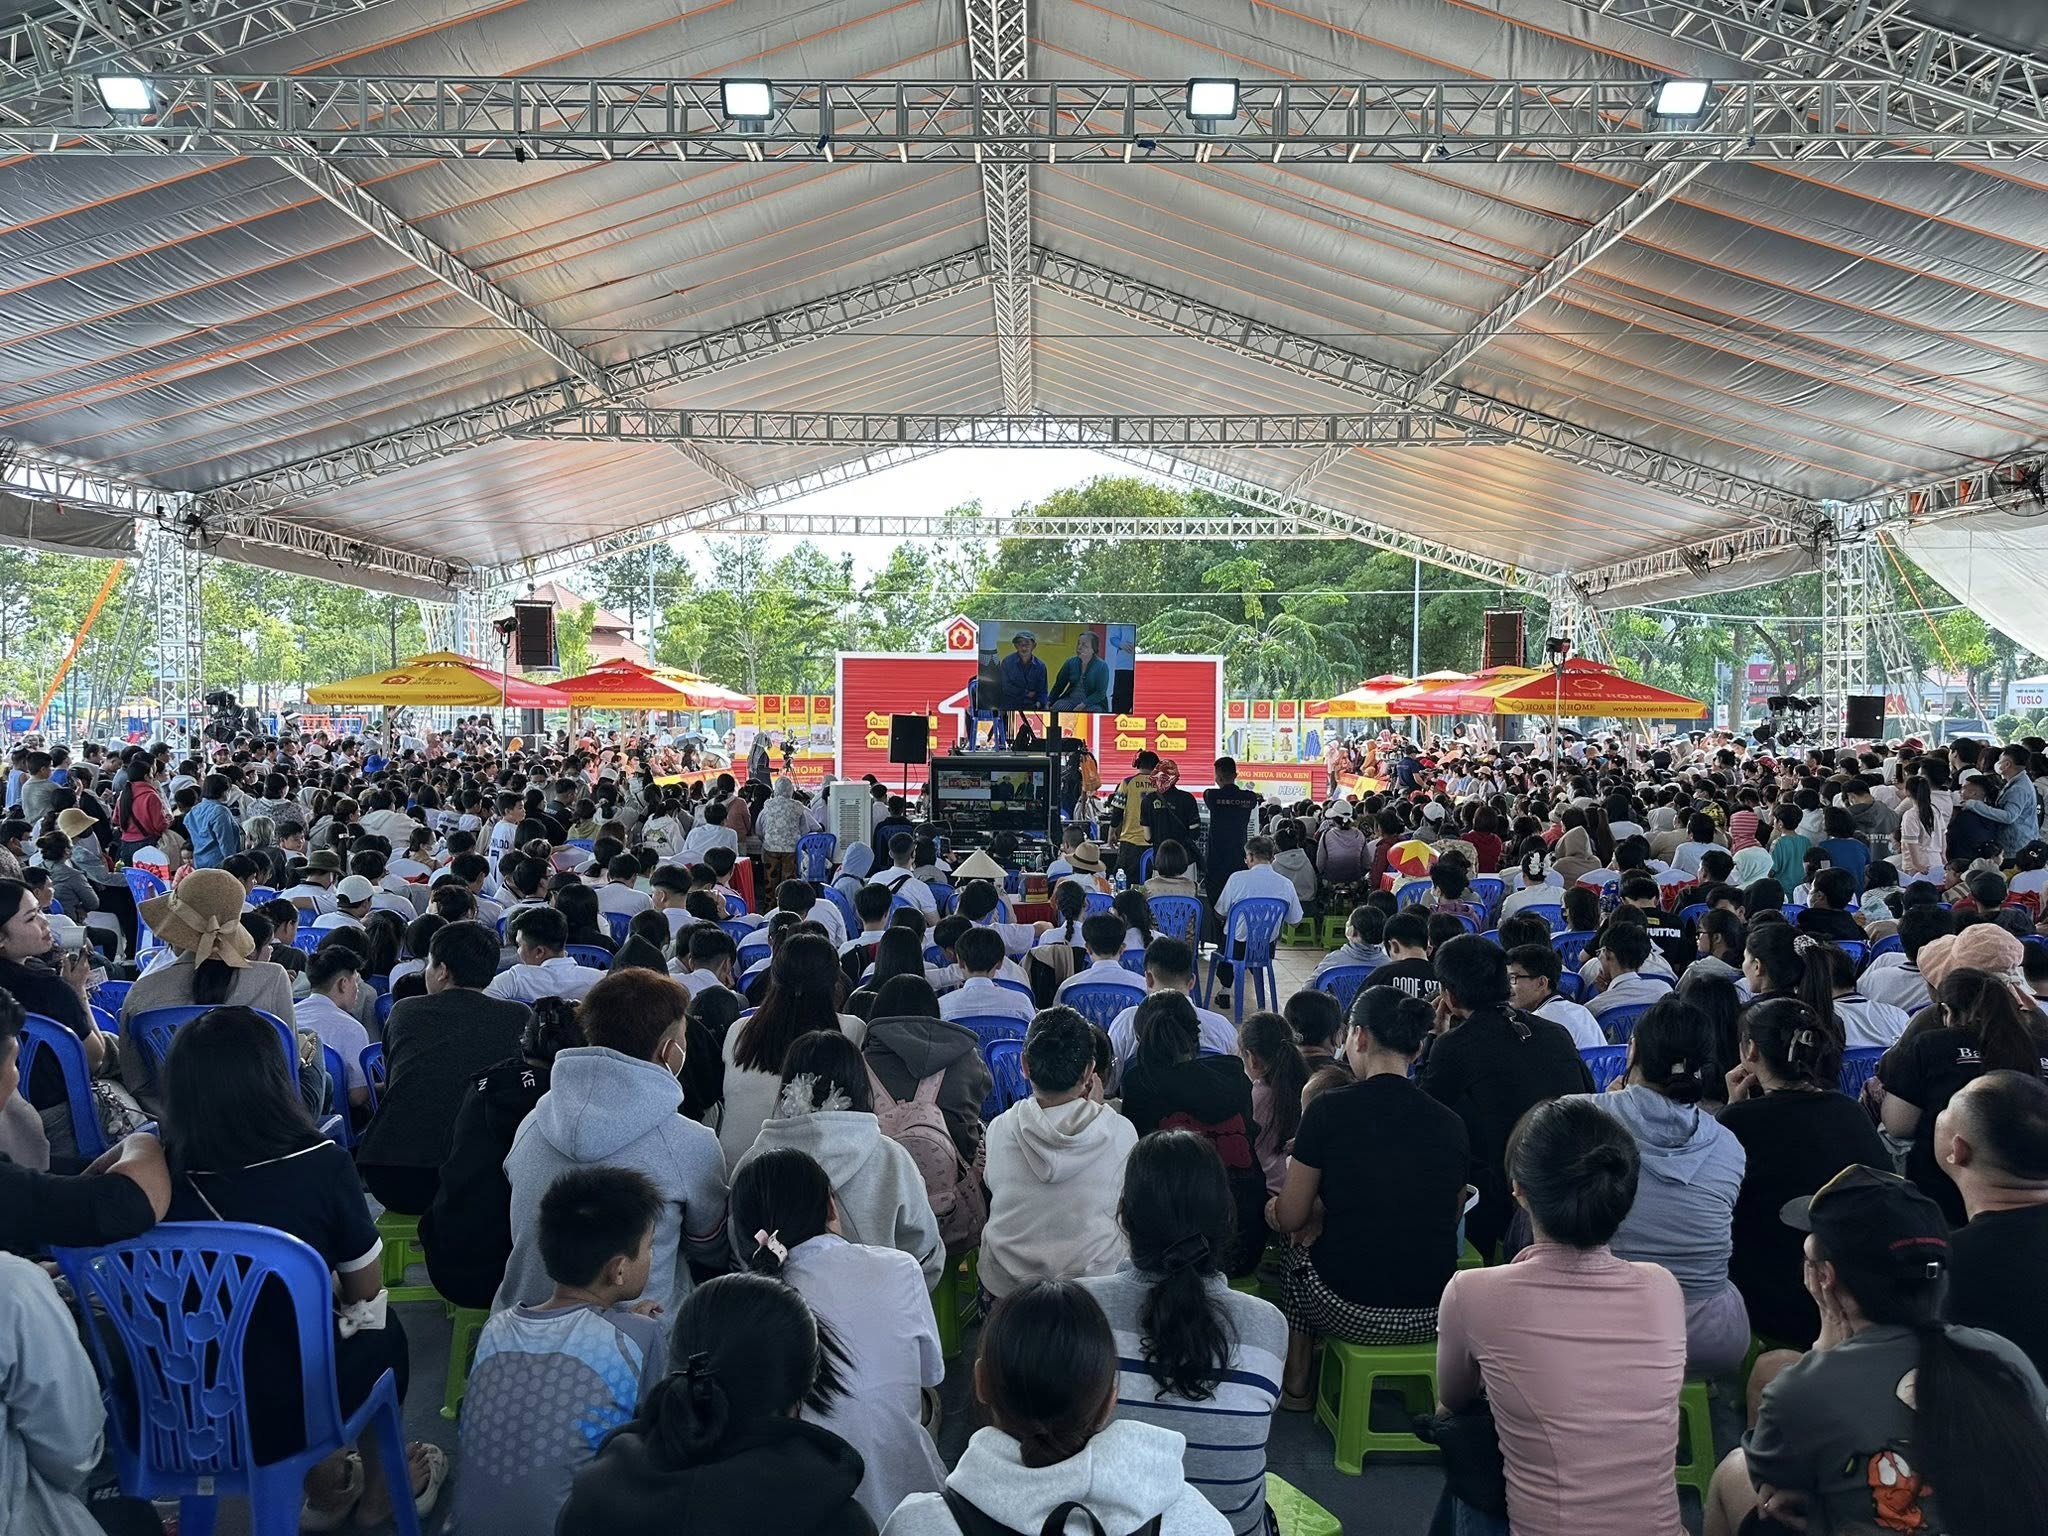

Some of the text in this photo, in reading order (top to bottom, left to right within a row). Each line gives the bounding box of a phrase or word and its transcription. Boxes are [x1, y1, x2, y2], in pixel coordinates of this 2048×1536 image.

[2016, 695, 2043, 705] TUSLO
[1525, 703, 1596, 711] HOA SEN HOME
[1612, 705, 1690, 713] www.hoasenhome.vn
[1276, 771, 1293, 779] HOA
[1278, 785, 1307, 796] HDPE
[1957, 1047, 1981, 1058] Ba
[520, 1070, 536, 1088] KE
